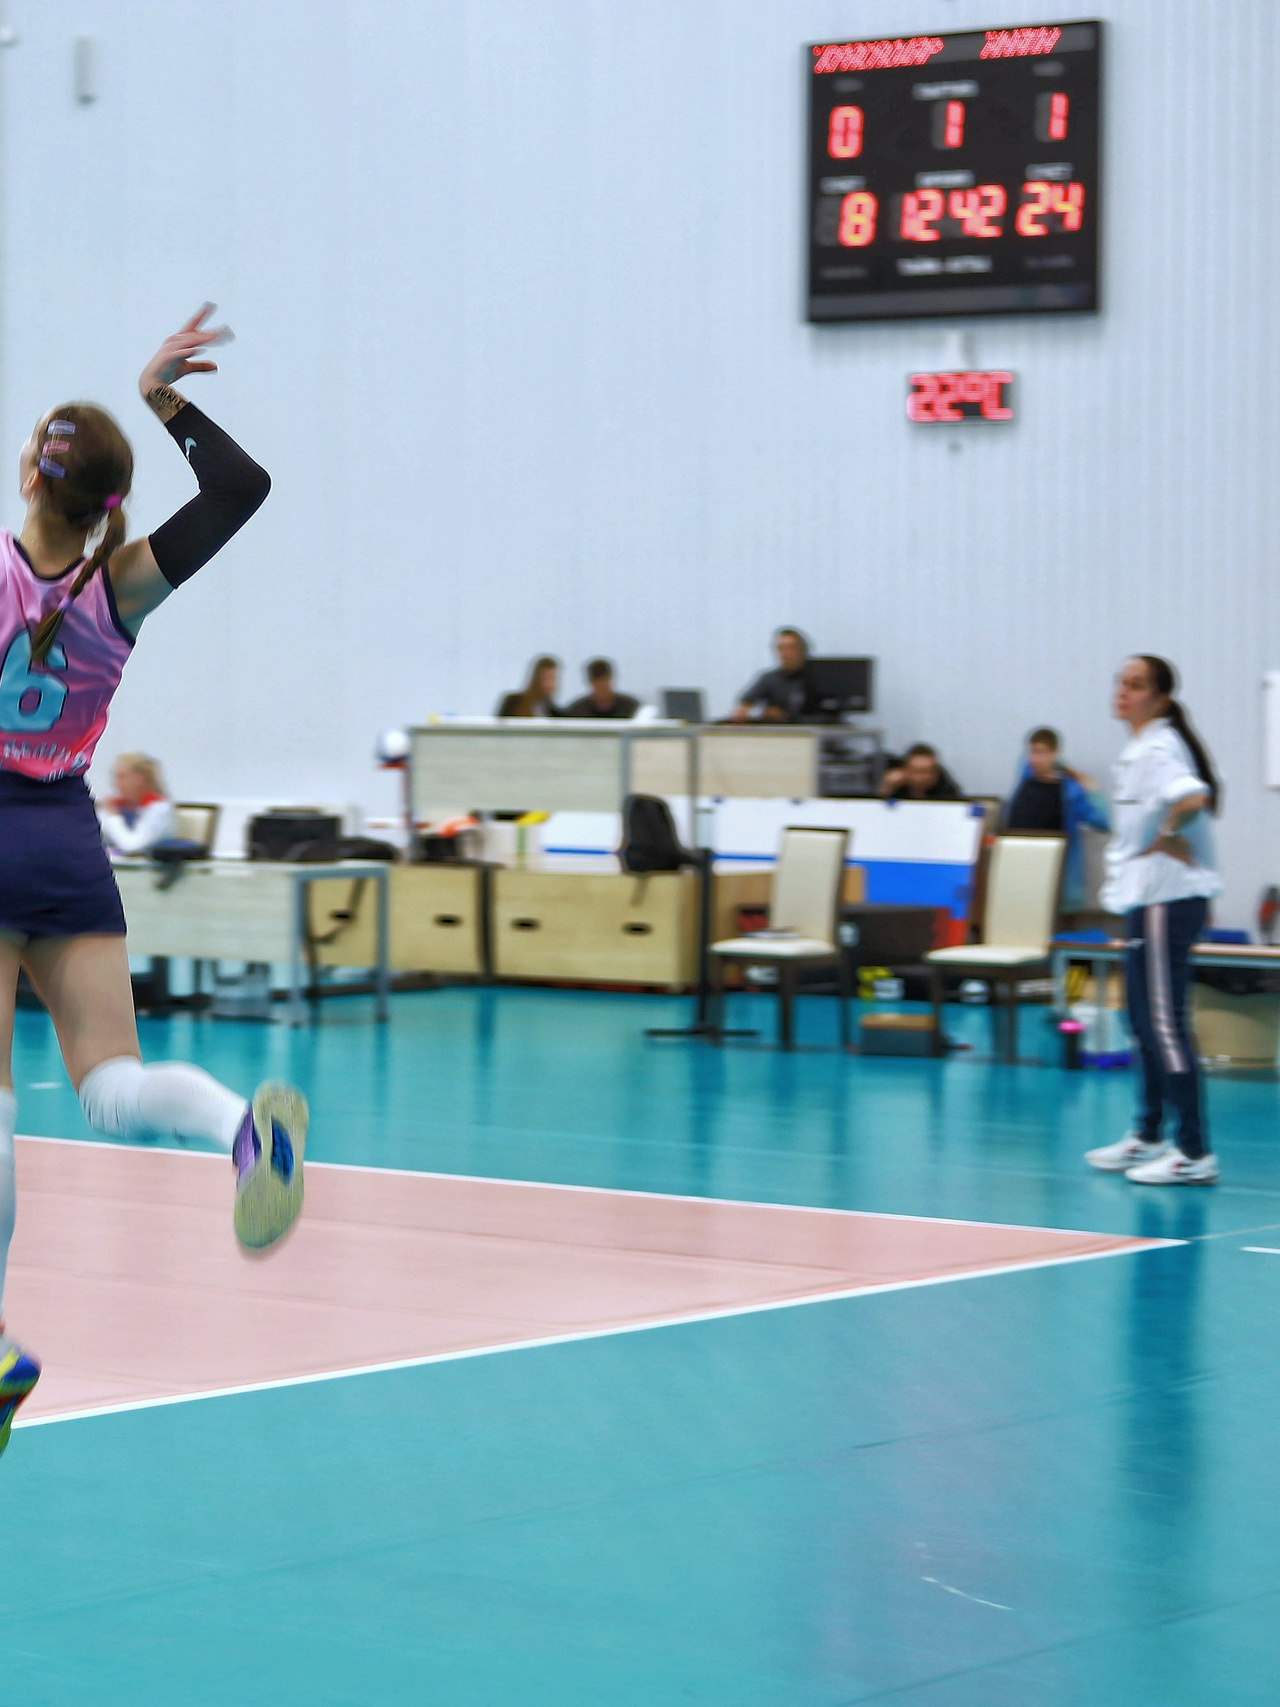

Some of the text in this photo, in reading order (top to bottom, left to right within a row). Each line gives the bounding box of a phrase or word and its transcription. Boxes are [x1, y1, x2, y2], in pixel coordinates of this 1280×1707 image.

[828, 105, 864, 159] 0
[944, 100, 965, 148] 1
[1047, 92, 1069, 140] 1
[838, 191, 878, 247] 8
[1015, 180, 1085, 237] 24
